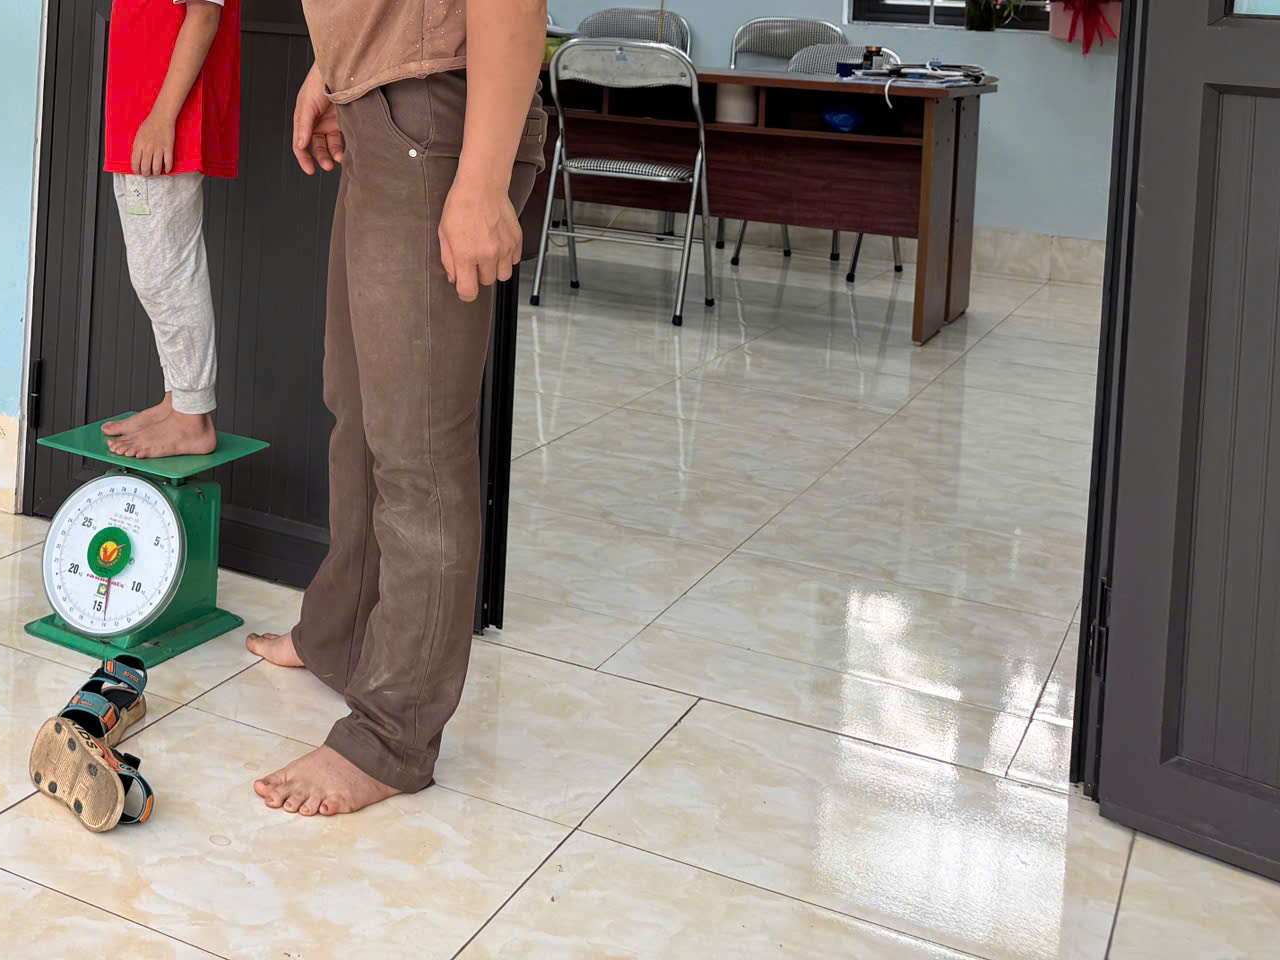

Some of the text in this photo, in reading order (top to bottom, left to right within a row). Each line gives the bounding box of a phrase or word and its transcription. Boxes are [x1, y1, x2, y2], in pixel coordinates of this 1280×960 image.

[124, 502, 135, 514] 30
[81, 516, 93, 528] 25
[153, 535, 161, 547] 5
[67, 562, 79, 575] 20
[131, 580, 142, 593] 10
[92, 599, 103, 612] 15
